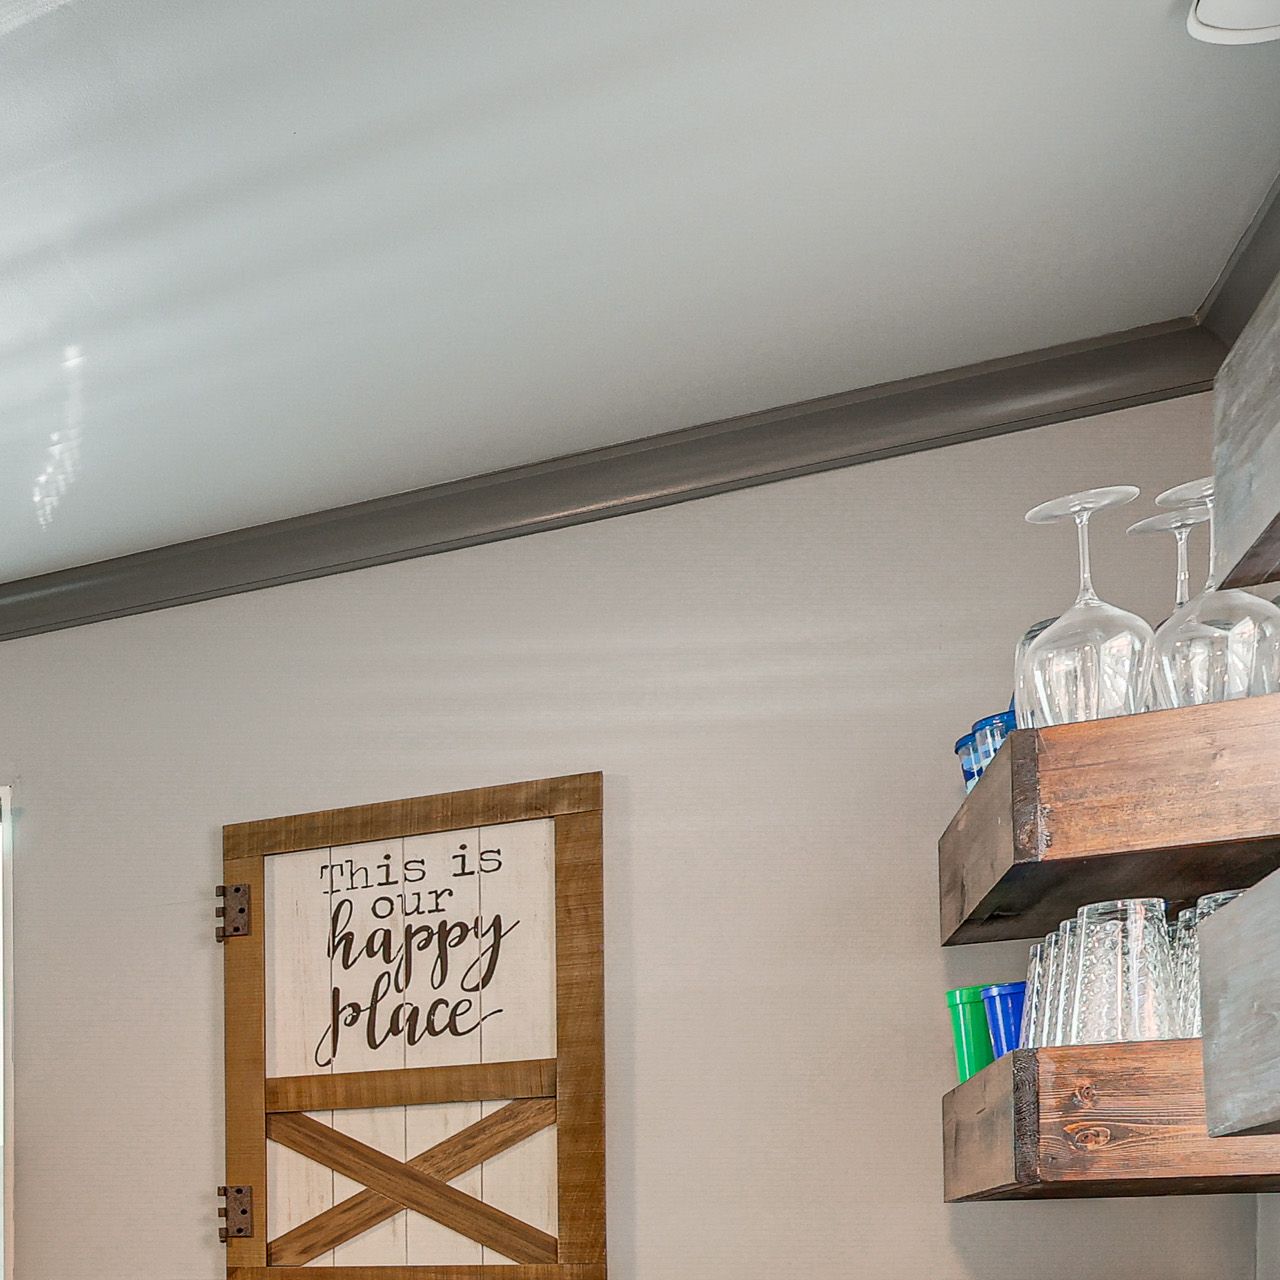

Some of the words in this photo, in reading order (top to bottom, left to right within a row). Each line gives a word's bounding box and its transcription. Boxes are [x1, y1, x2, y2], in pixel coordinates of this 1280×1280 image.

[320, 854, 427, 895] This
[452, 844, 503, 878] is
[371, 887, 454, 919] our
[327, 899, 520, 993] happy
[315, 971, 503, 1068] place
